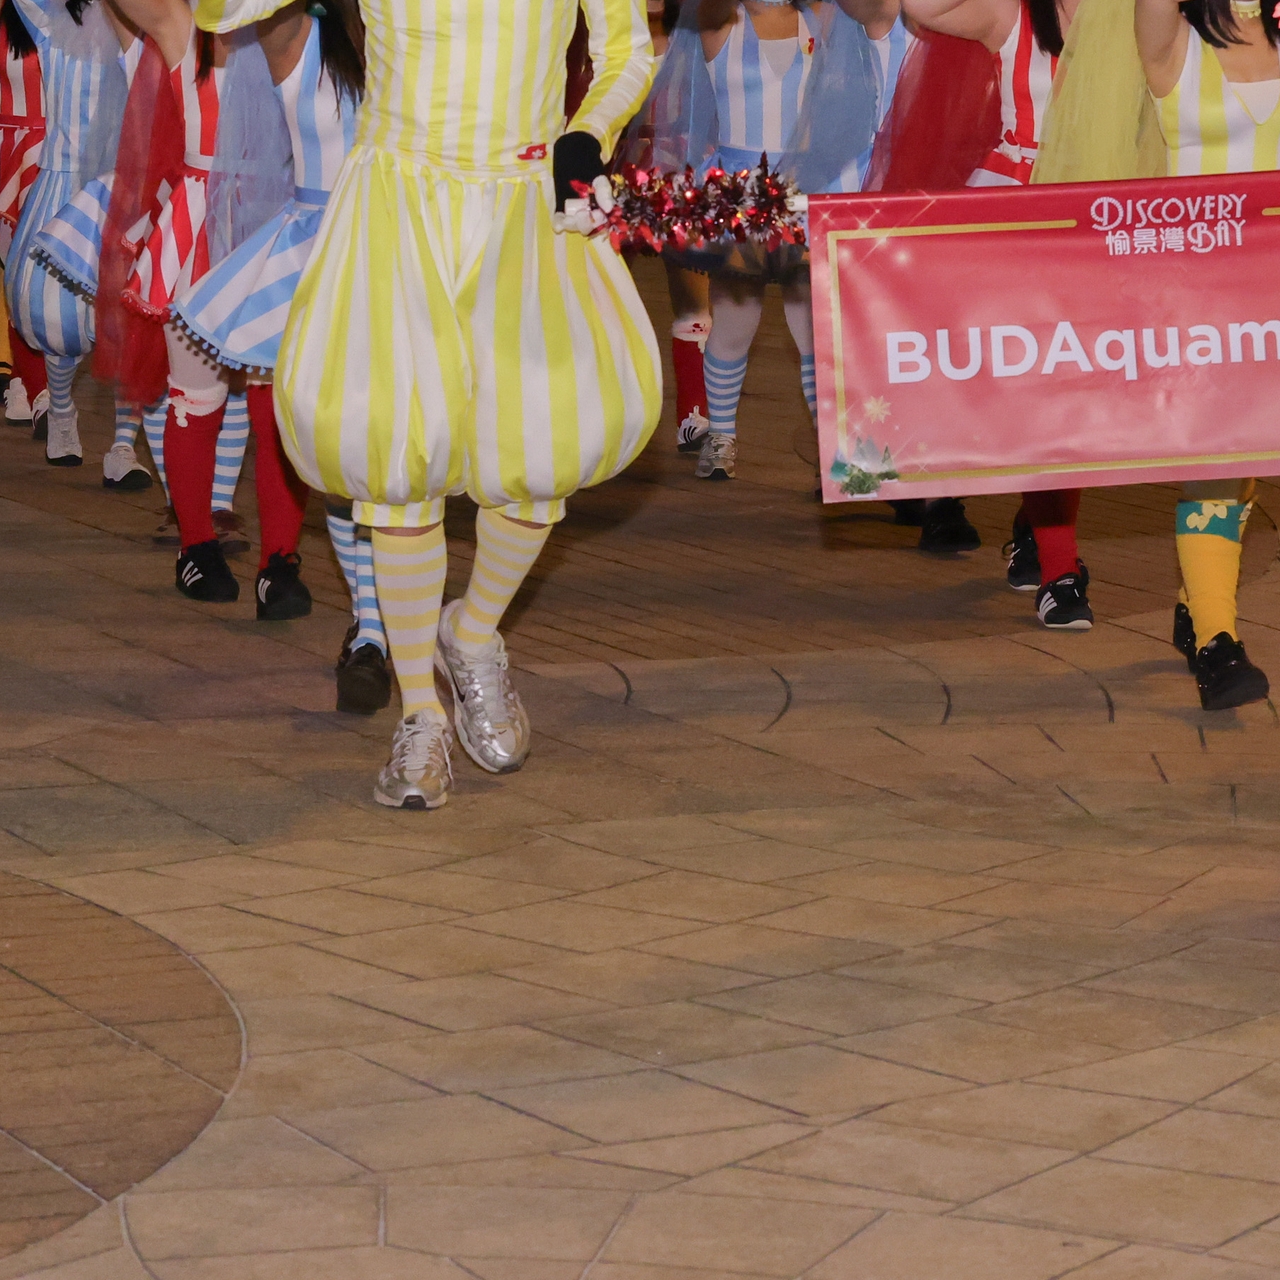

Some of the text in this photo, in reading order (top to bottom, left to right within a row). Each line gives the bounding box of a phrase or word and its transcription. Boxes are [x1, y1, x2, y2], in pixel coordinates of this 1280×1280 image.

[1090, 194, 1247, 231] DISCOVERY
[1105, 219, 1246, 256] 愉景灣 BAY
